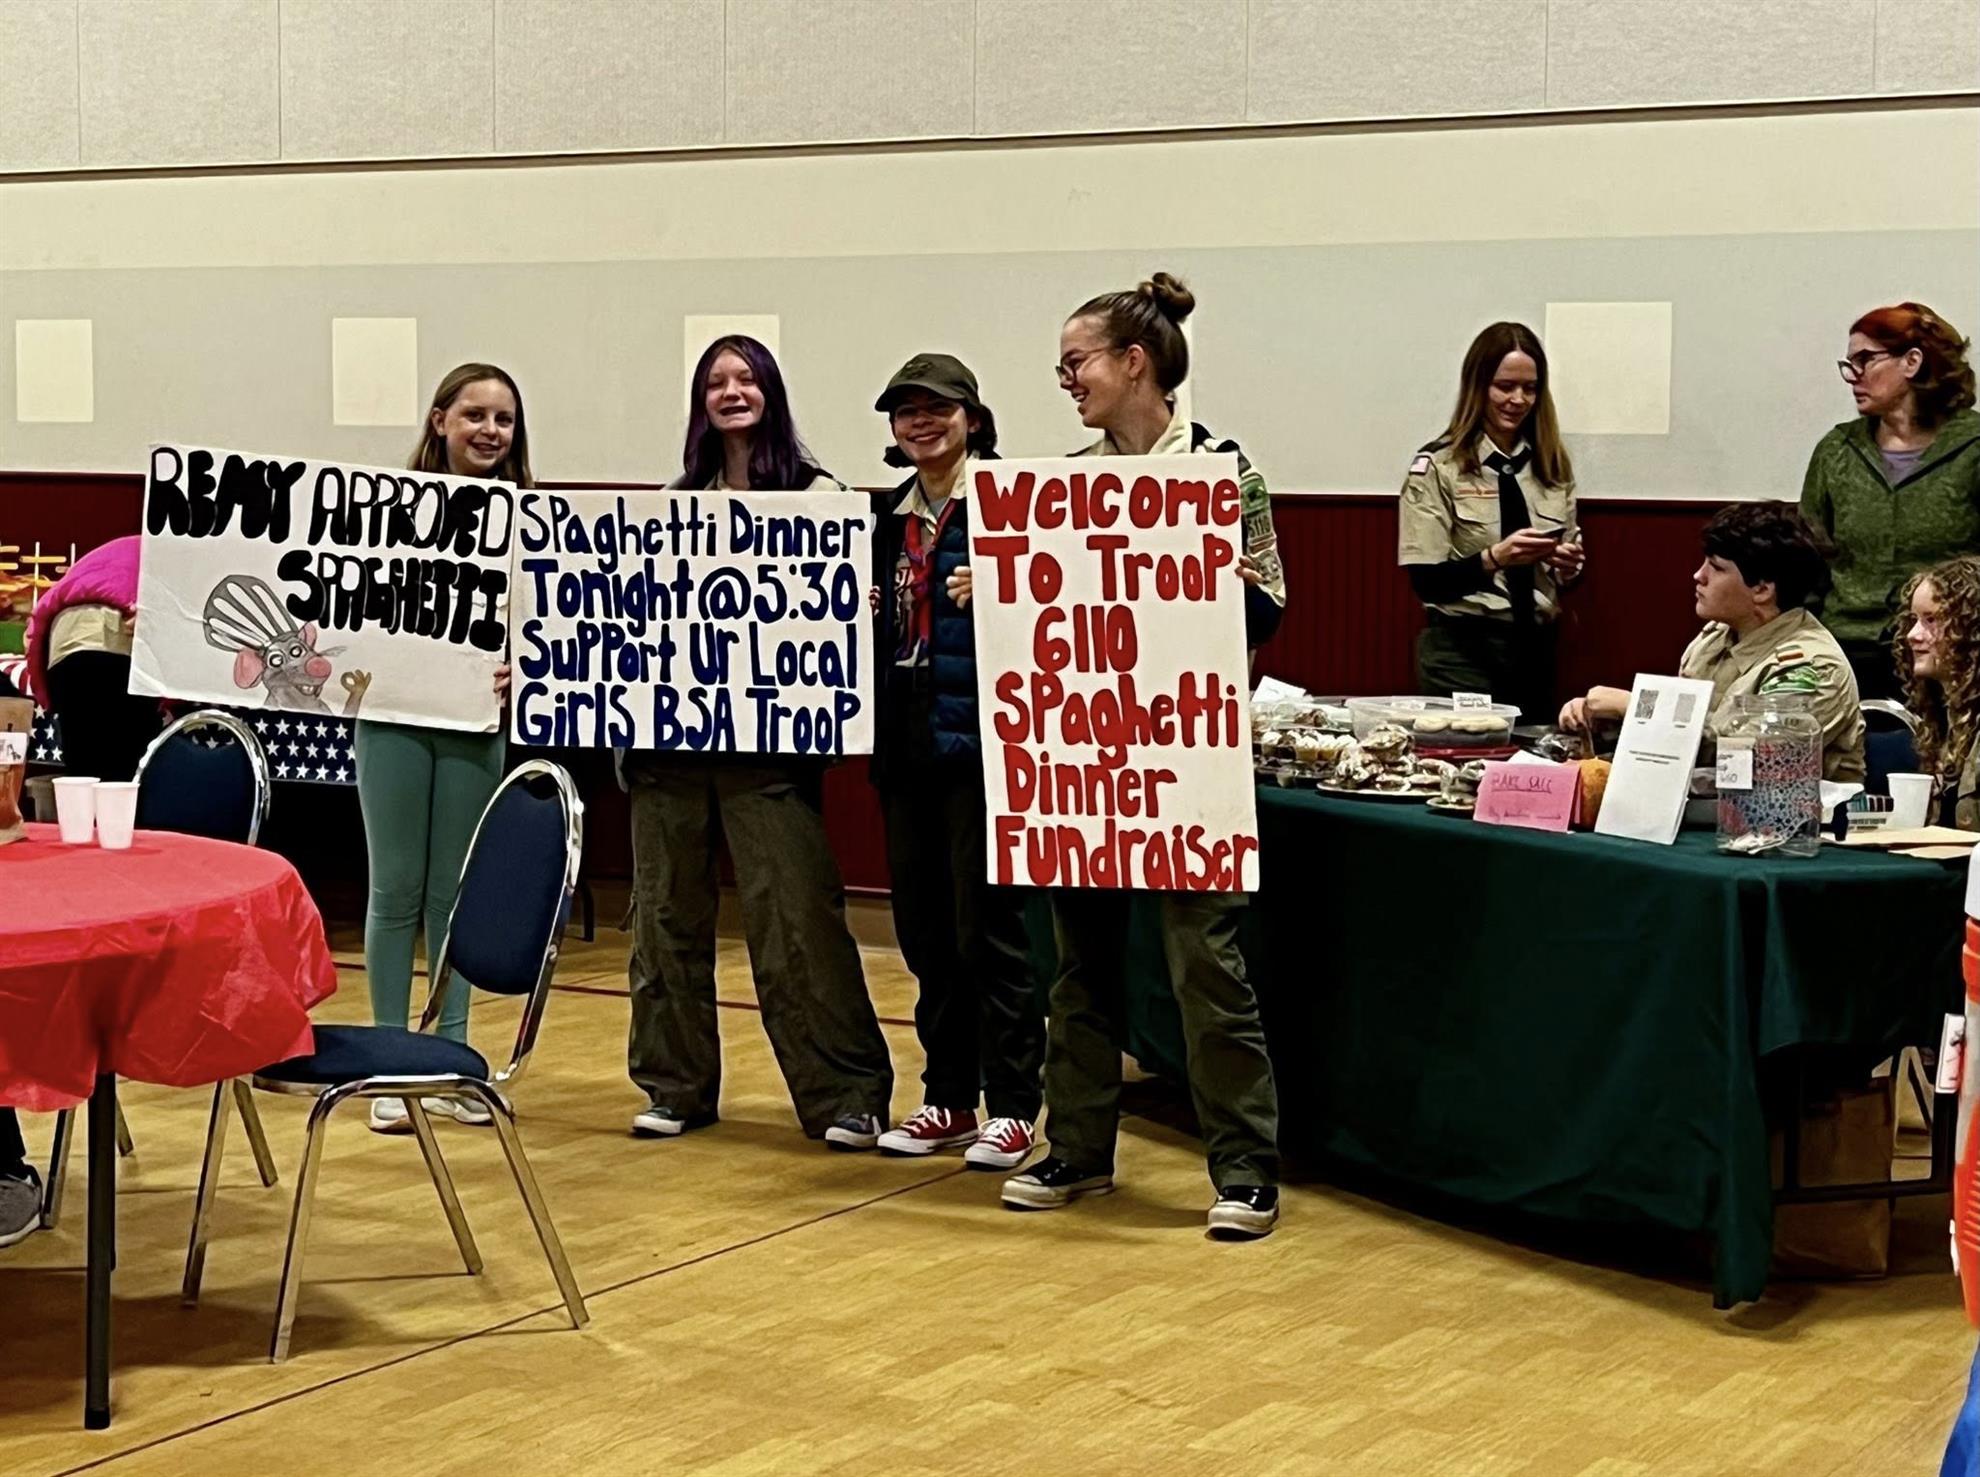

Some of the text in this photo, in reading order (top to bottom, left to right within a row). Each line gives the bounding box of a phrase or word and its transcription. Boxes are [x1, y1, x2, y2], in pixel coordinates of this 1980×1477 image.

[147, 447, 514, 557] REMY APPROVED
[729, 498, 865, 559] Dinner
[277, 550, 507, 652] SPAGHETTI
[521, 558, 694, 638] Tonight
[973, 535, 1063, 604] To
[689, 622, 740, 685] Ur
[749, 621, 857, 688] Local
[1033, 604, 1138, 673] 6110
[654, 684, 736, 751] BSA
[1003, 742, 1177, 818] Dinner
